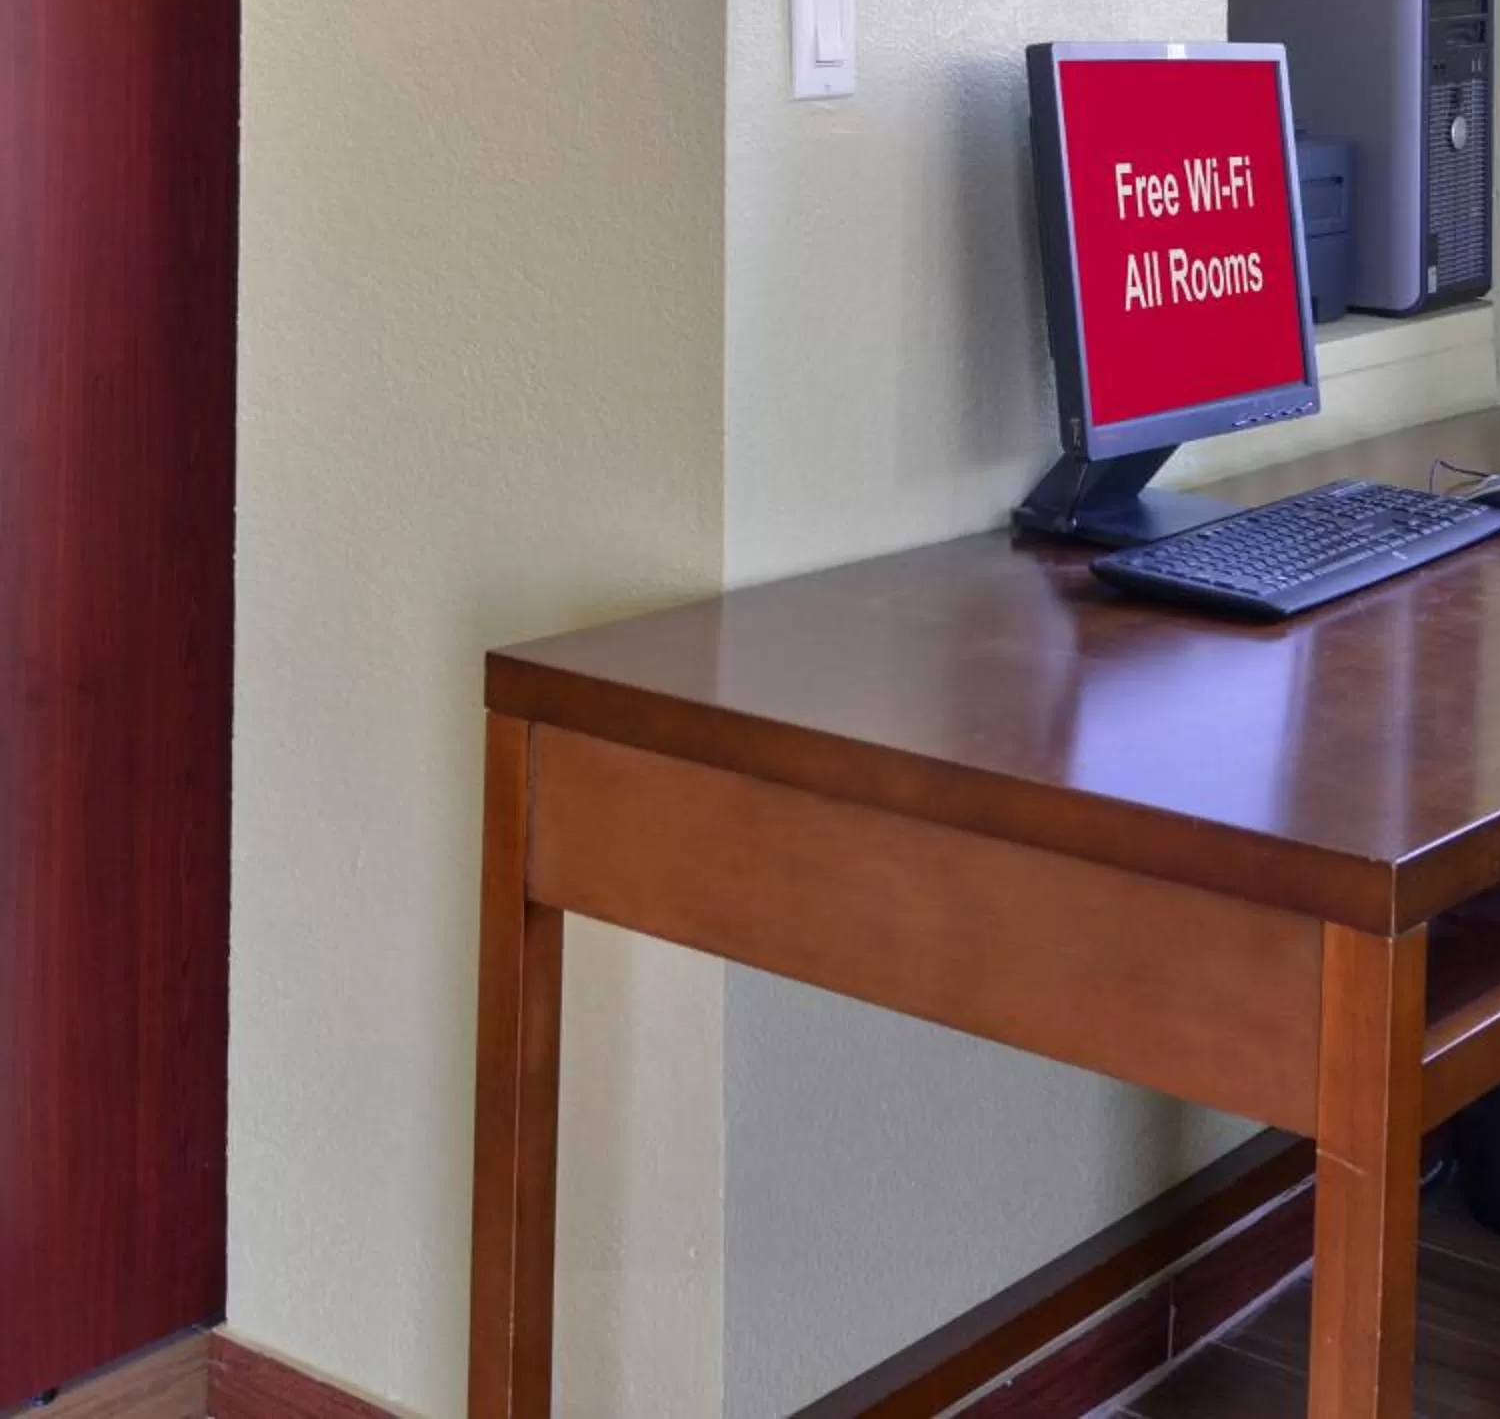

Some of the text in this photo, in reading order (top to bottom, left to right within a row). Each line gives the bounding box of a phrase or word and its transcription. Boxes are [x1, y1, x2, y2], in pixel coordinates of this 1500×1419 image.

[1115, 156, 1254, 219] Free Wi-Fi
[1125, 248, 1263, 311] All Rooms
